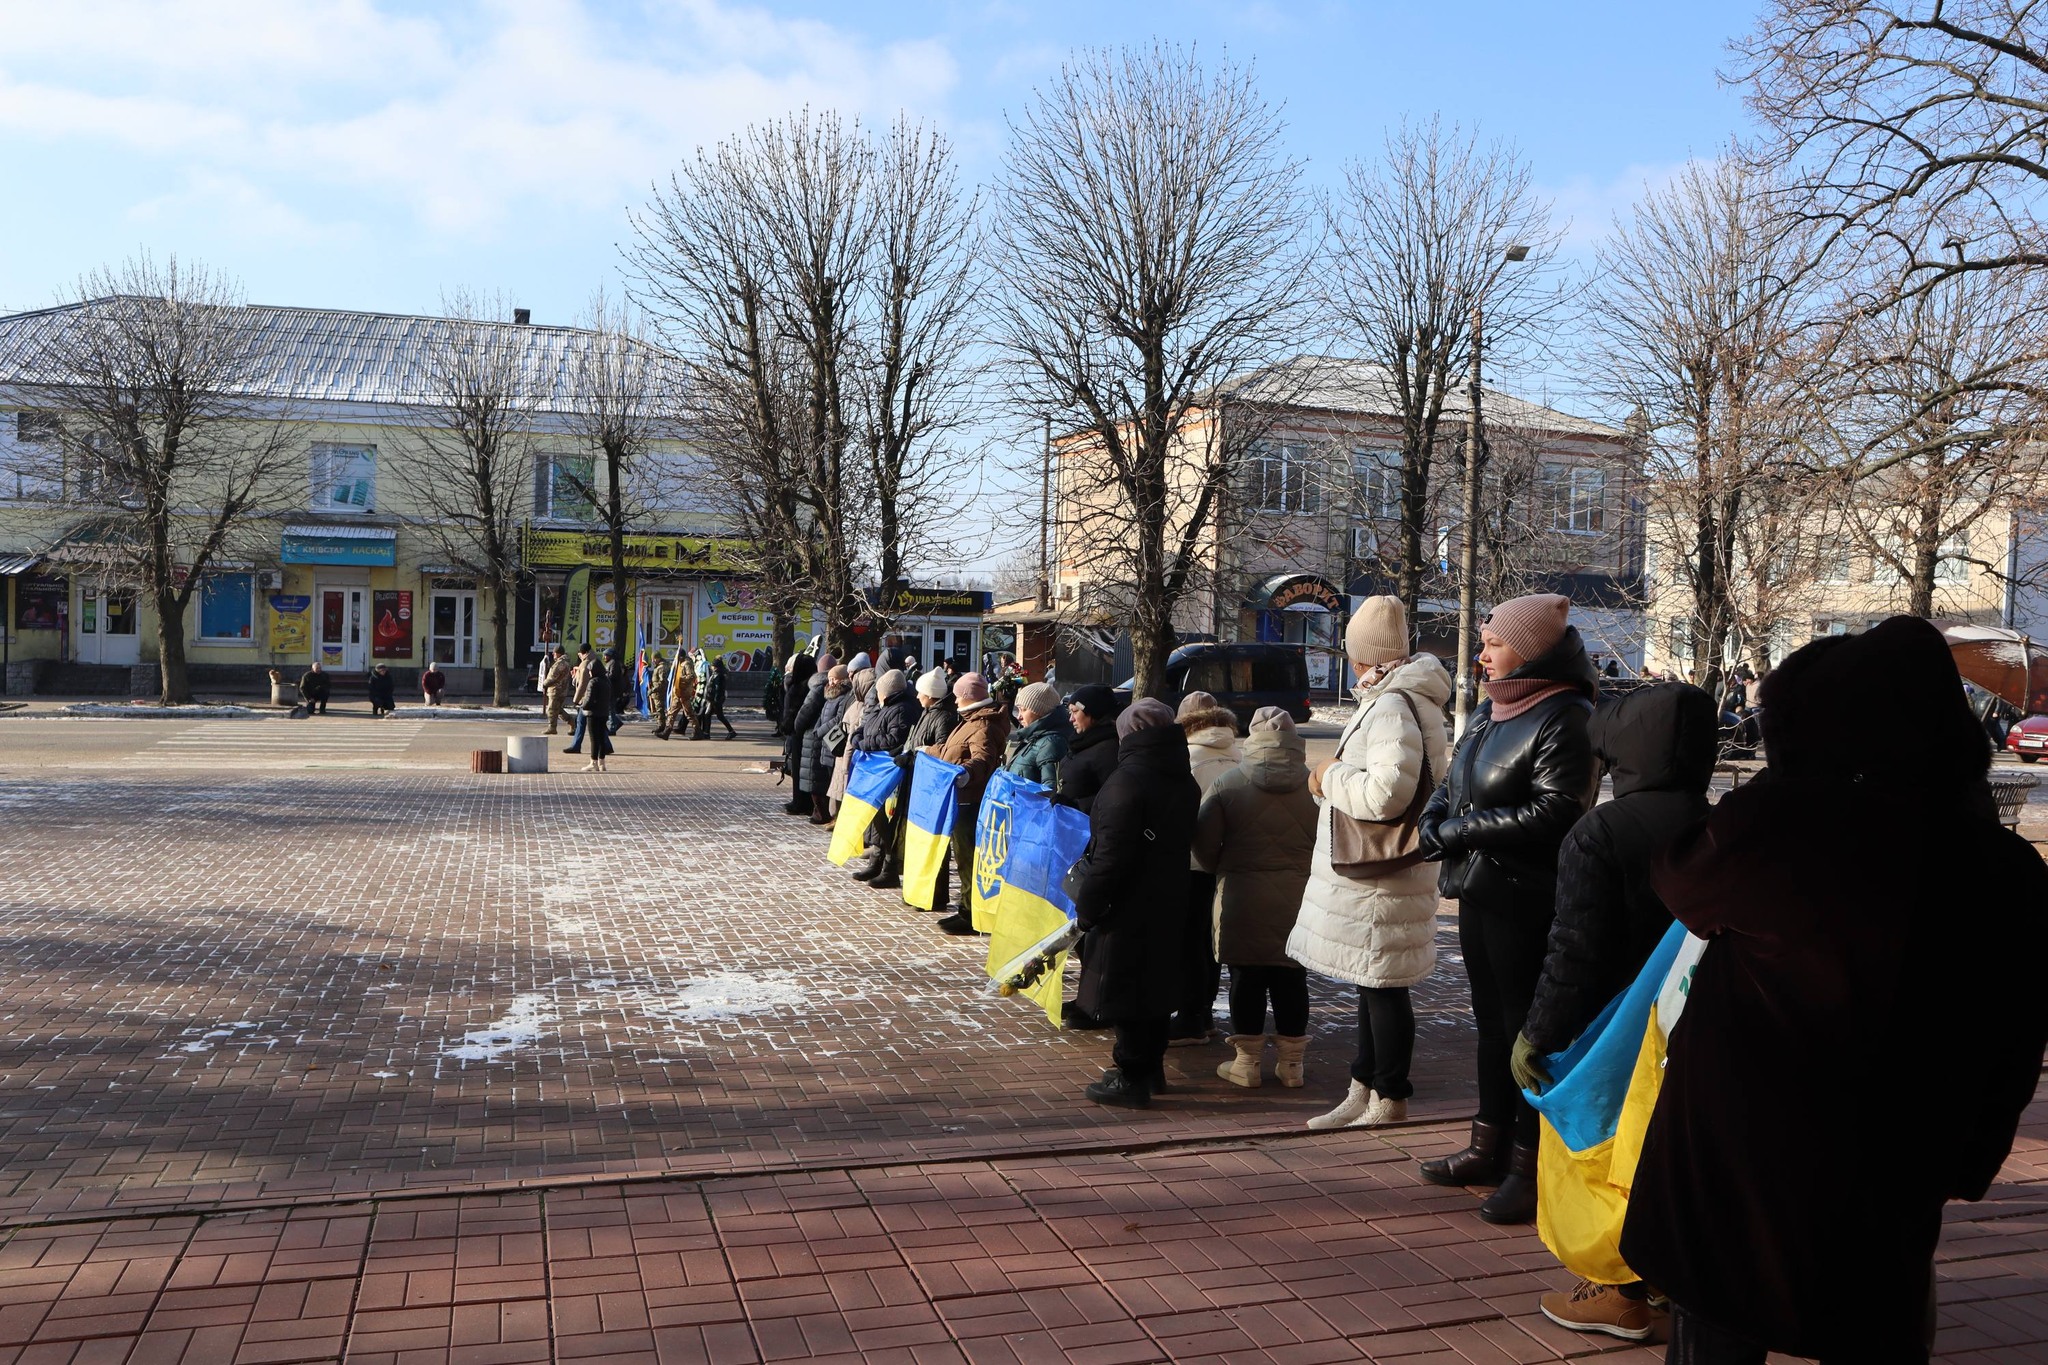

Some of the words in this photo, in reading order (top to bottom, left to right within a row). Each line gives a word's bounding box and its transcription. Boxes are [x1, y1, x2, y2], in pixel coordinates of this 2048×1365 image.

[302, 546, 345, 554] КИЇВСТАР
[352, 546, 393, 557] КАСКАД
[916, 596, 972, 605] ШАУРМАНІЯ
[1274, 582, 1340, 609] ФАВОРИТ
